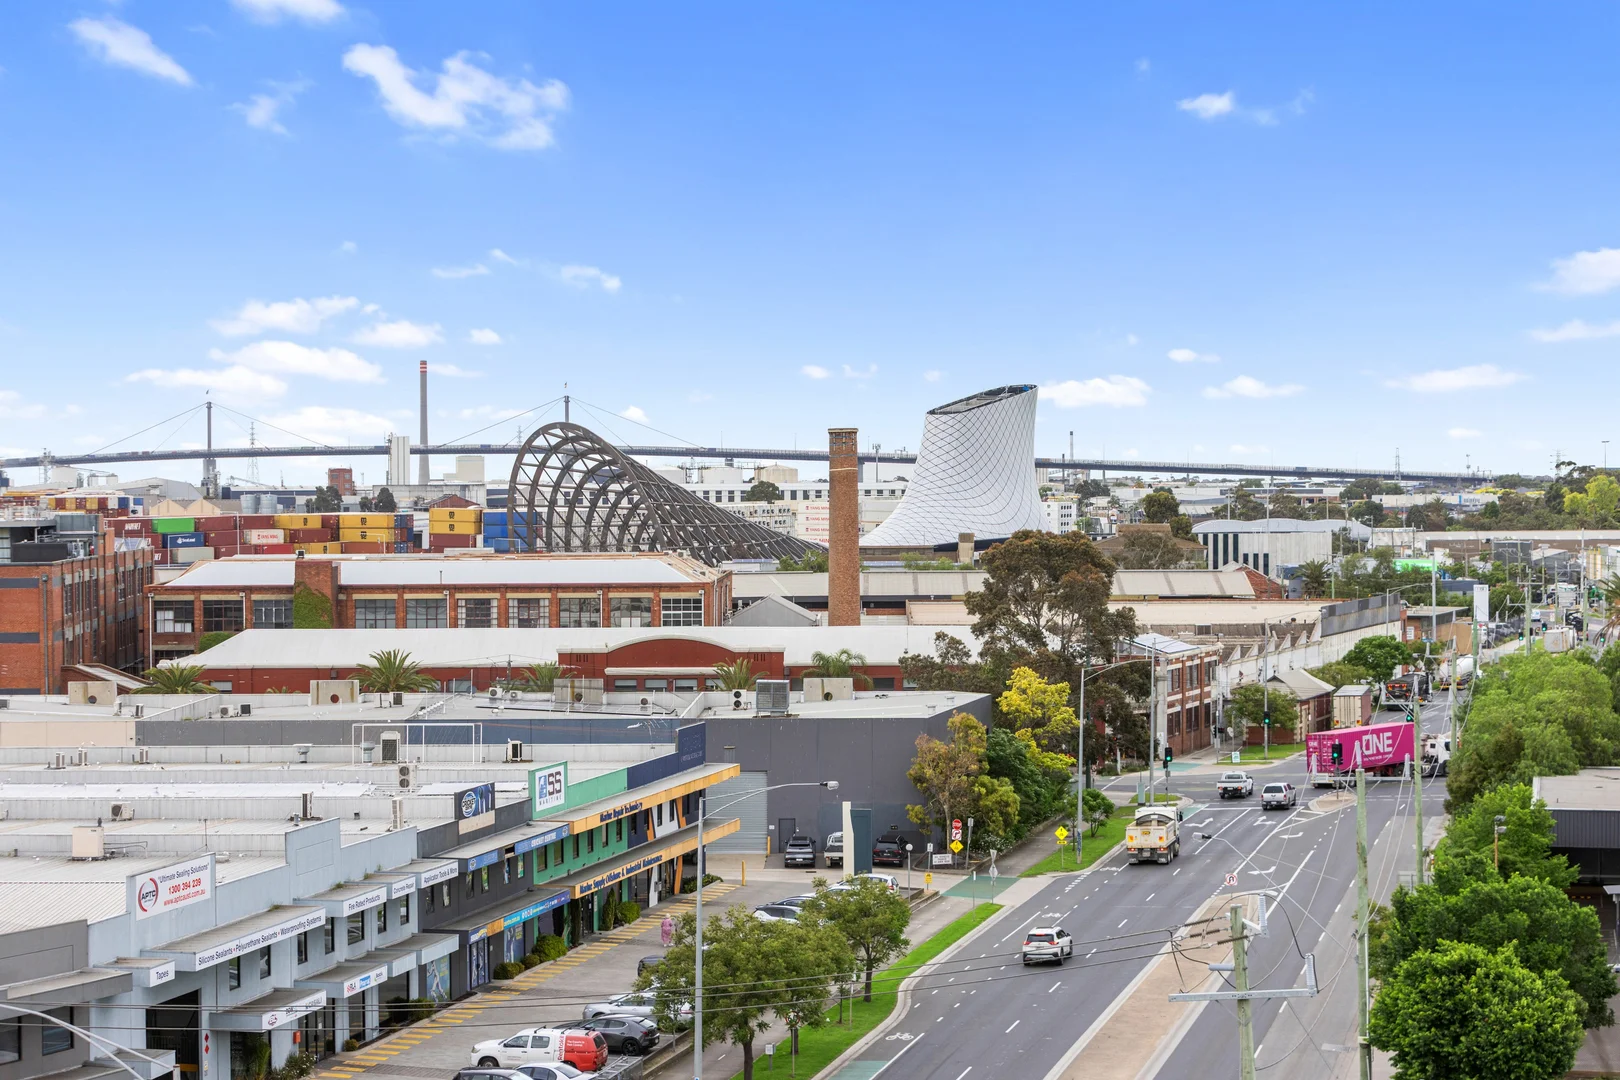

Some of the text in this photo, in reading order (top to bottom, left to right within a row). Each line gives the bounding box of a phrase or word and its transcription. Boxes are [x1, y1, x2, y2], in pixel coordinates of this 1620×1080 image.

[1362, 732, 1393, 755] ONE
[176, 869, 190, 879] Sealing
[169, 884, 180, 894] 1300
[182, 881, 191, 891] 394
[393, 882, 414, 895] Concrete Repair
[580, 882, 592, 894] Marine
[141, 890, 156, 900] APTC
[355, 899, 365, 909] Rated
[366, 894, 381, 906] Products
[198, 915, 322, 965] Silicone Sealants Polyurethane Sealants Waterproofing Systems
[156, 970, 169, 981] Tapes
